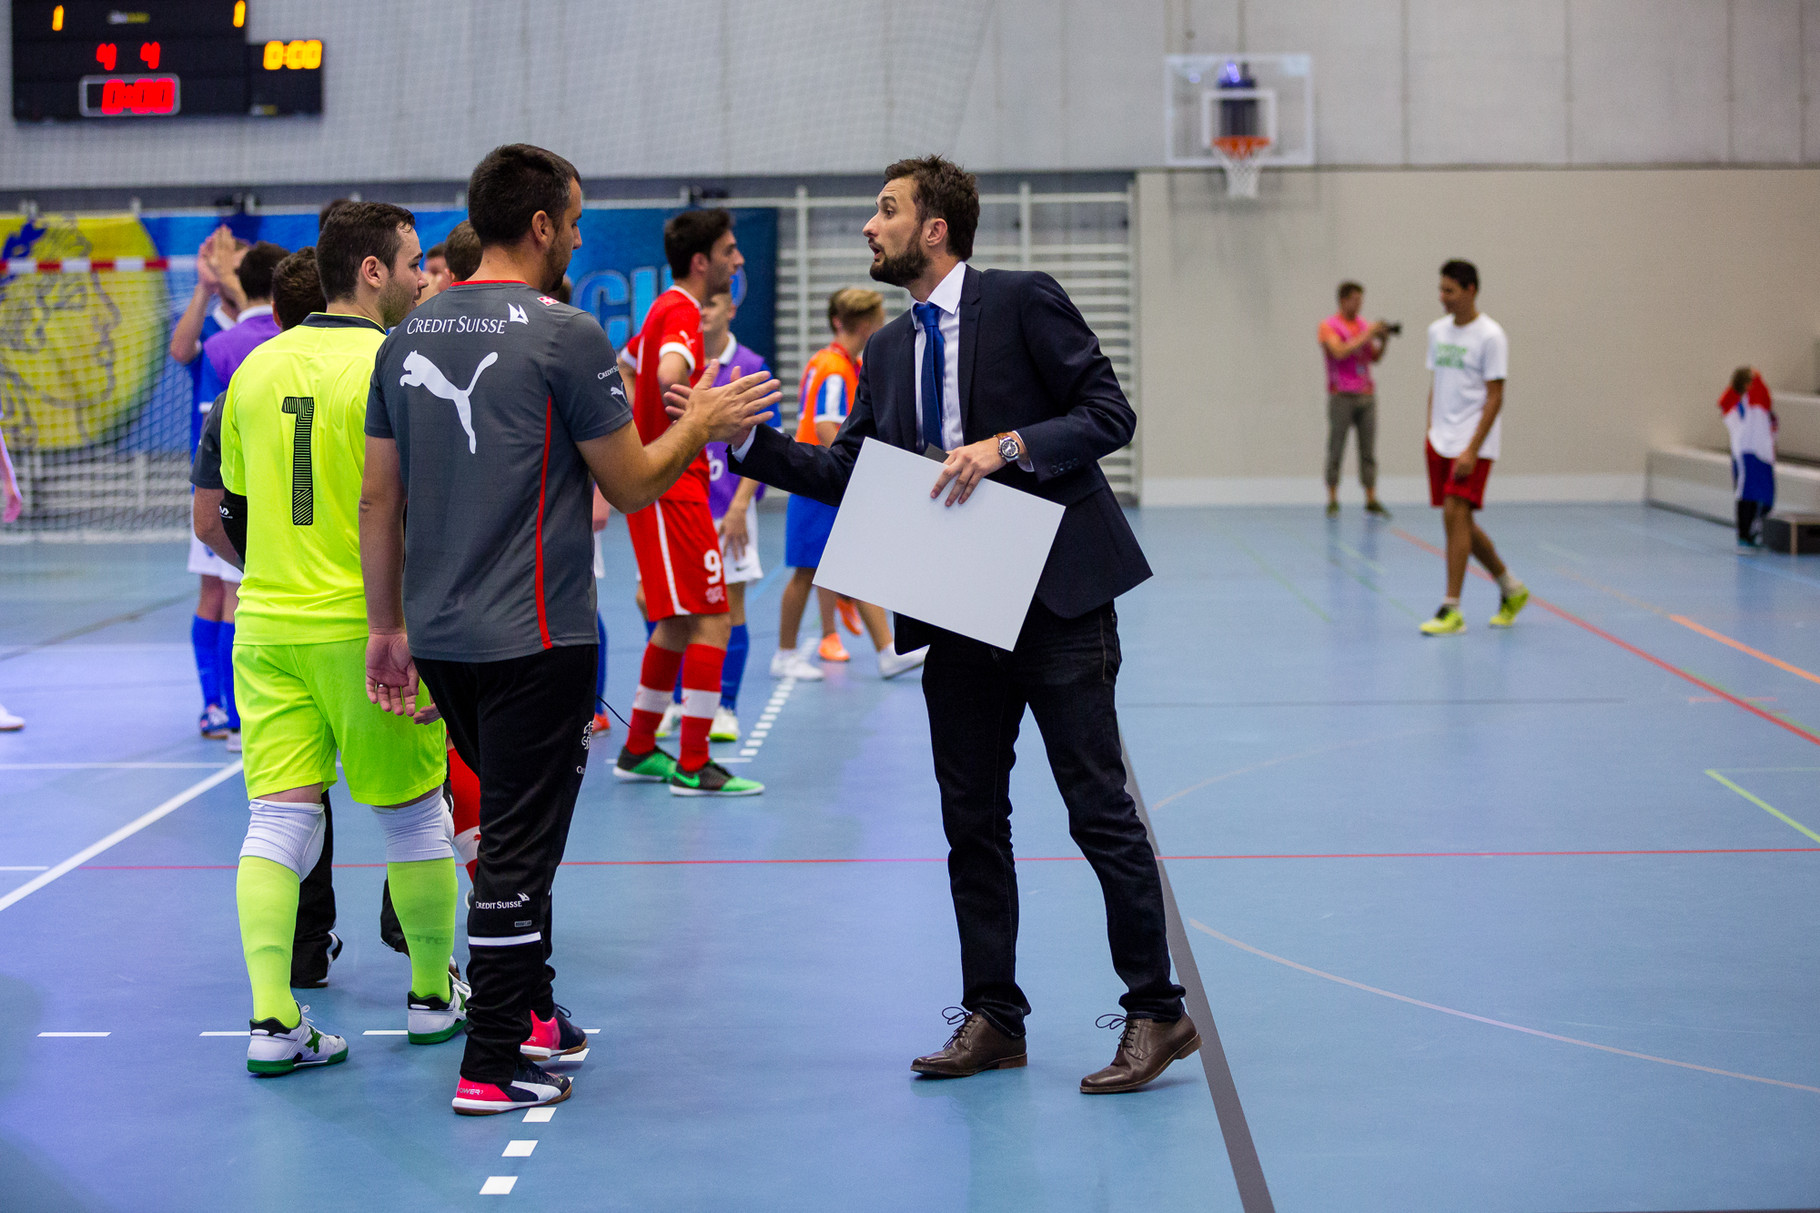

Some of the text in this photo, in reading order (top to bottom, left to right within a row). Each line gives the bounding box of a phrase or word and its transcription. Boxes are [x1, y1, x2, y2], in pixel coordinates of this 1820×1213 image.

[52, 5, 64, 31] 1
[233, 0, 246, 27] 1
[96, 42, 161, 70] 4 4
[263, 40, 322, 70] 0:00
[102, 78, 175, 114] 0:00
[407, 315, 508, 334] CREDIT SUISSE
[281, 396, 315, 526] 1
[703, 549, 723, 585] 9
[475, 900, 523, 910] CREDIT SUISSE
